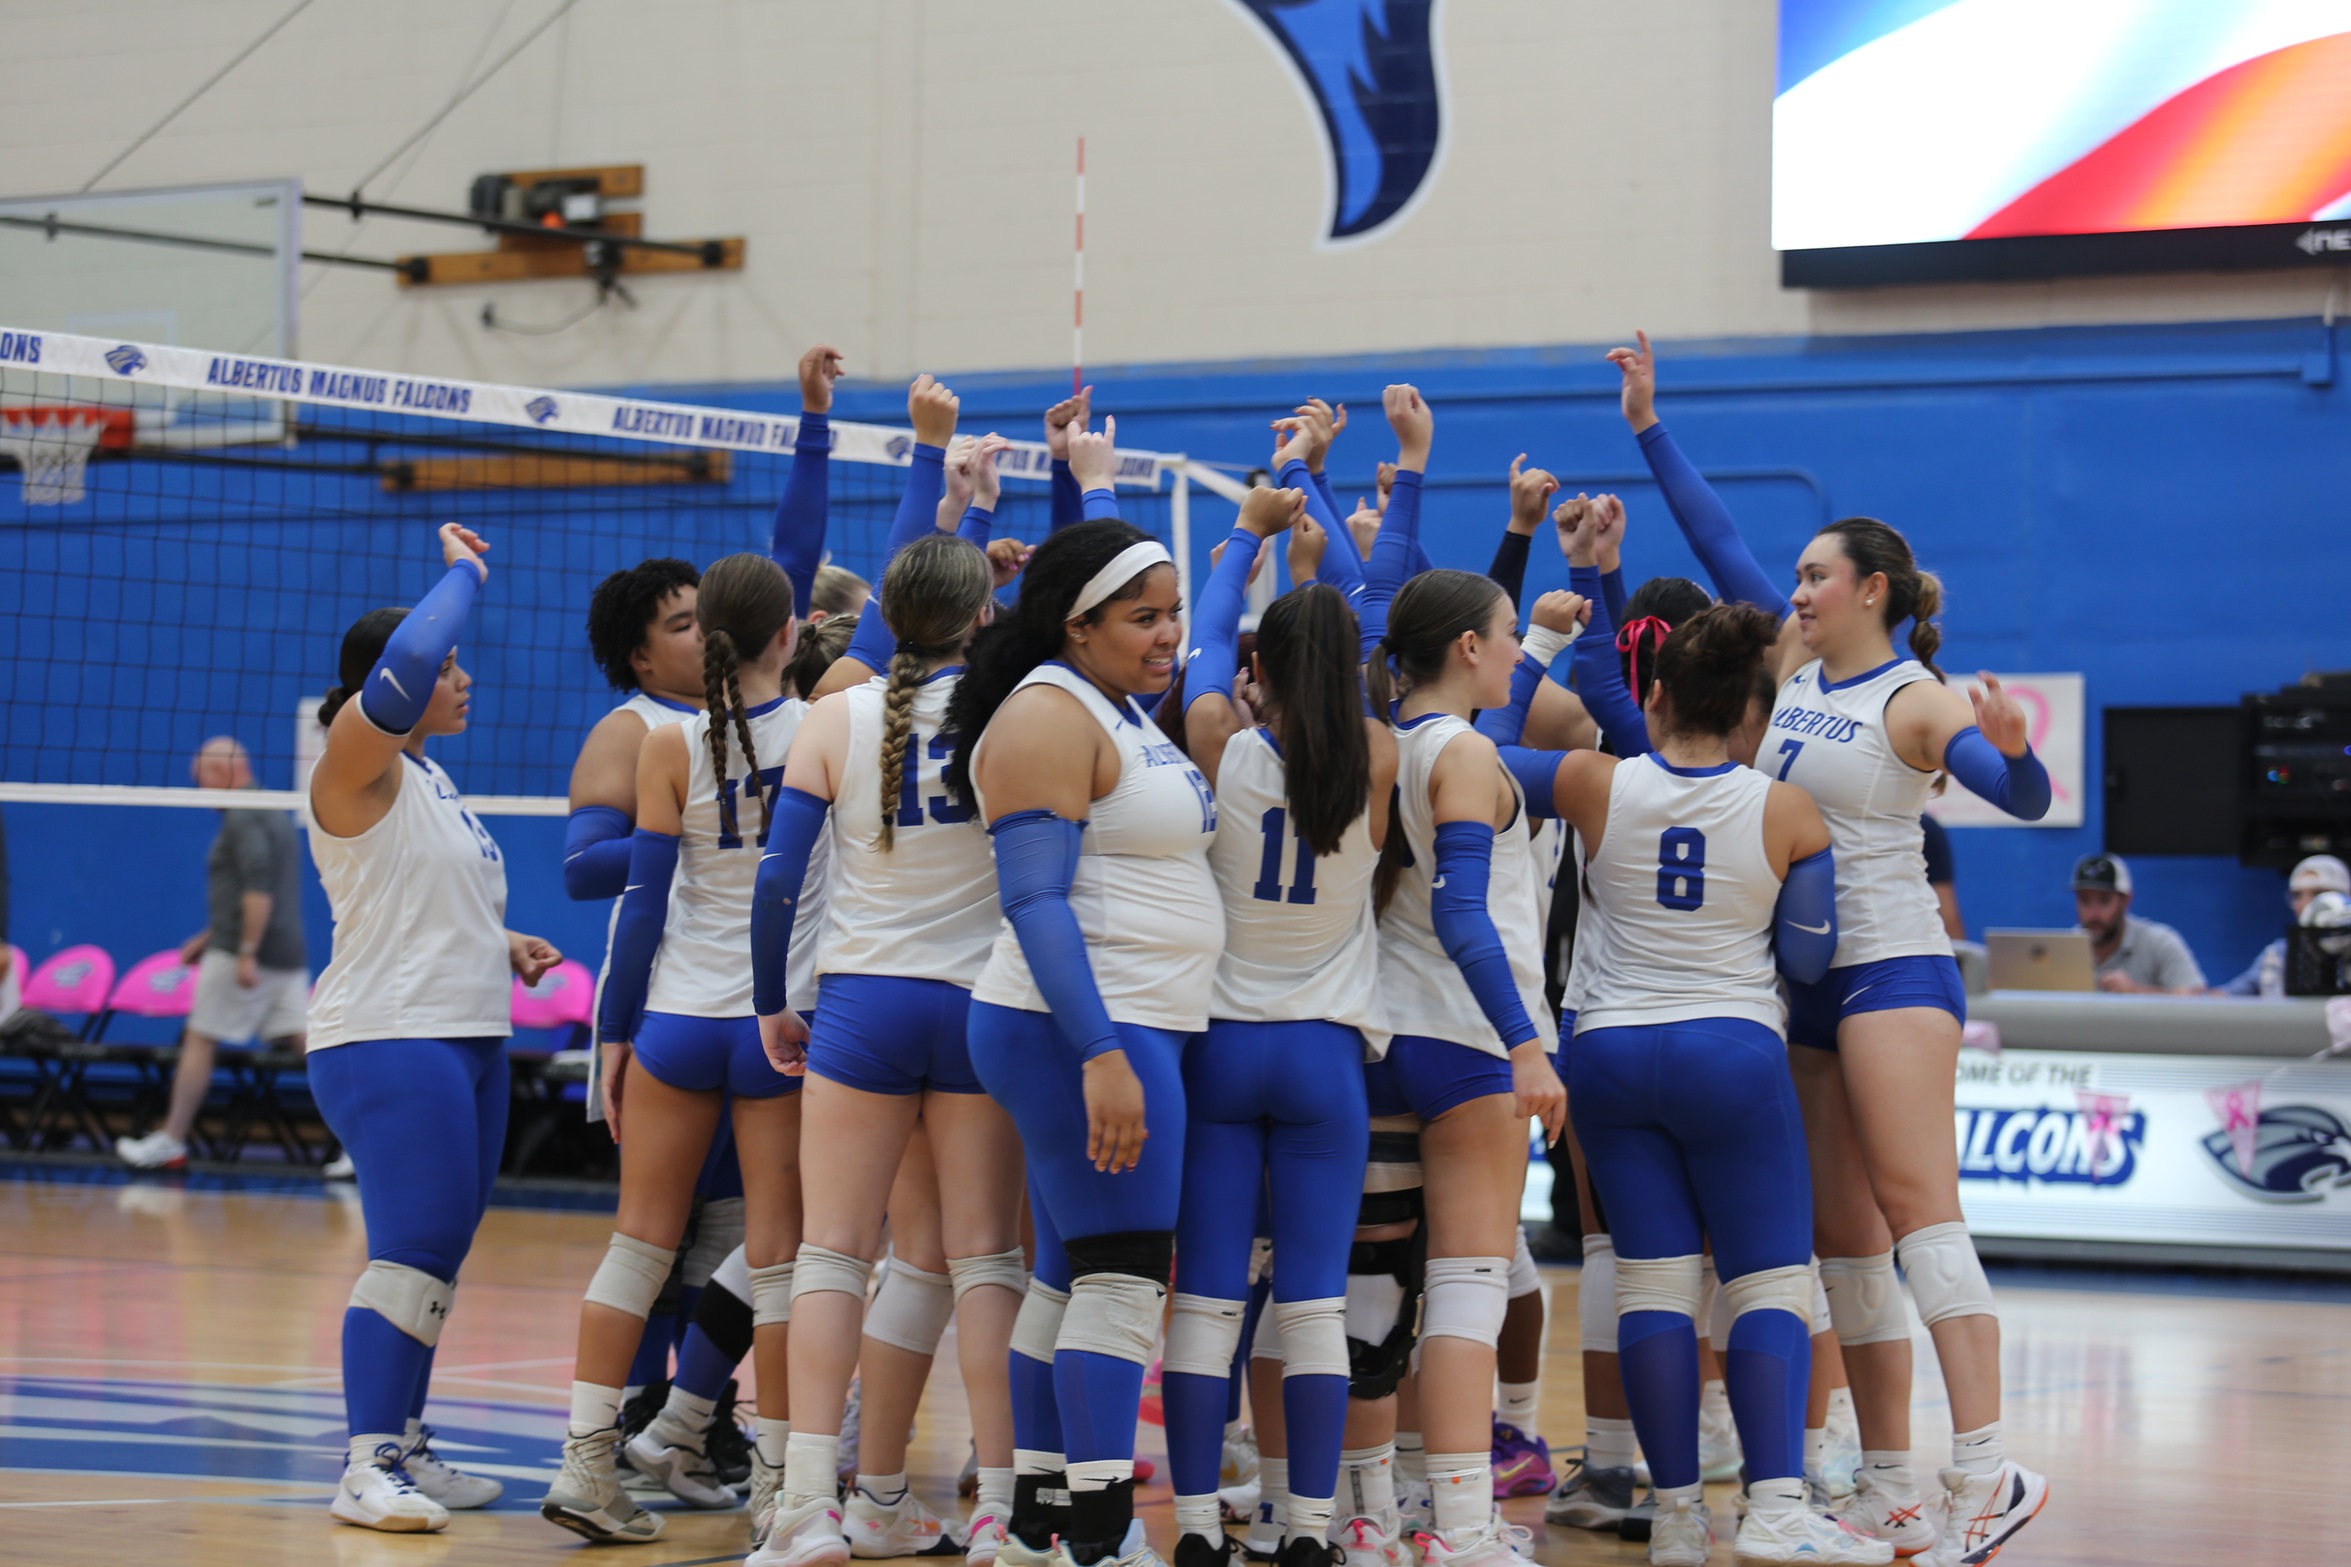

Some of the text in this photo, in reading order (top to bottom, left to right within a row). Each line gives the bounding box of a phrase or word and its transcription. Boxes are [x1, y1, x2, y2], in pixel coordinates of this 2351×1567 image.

[207, 357, 472, 413] ALBERTUS MAGNUS FALCONS
[1777, 738, 1806, 783] 7
[1253, 806, 1318, 906] 11
[1656, 826, 1707, 912] 8
[1956, 1062, 2094, 1086] OME OF THE
[1954, 1106, 2146, 1186] LCONS
